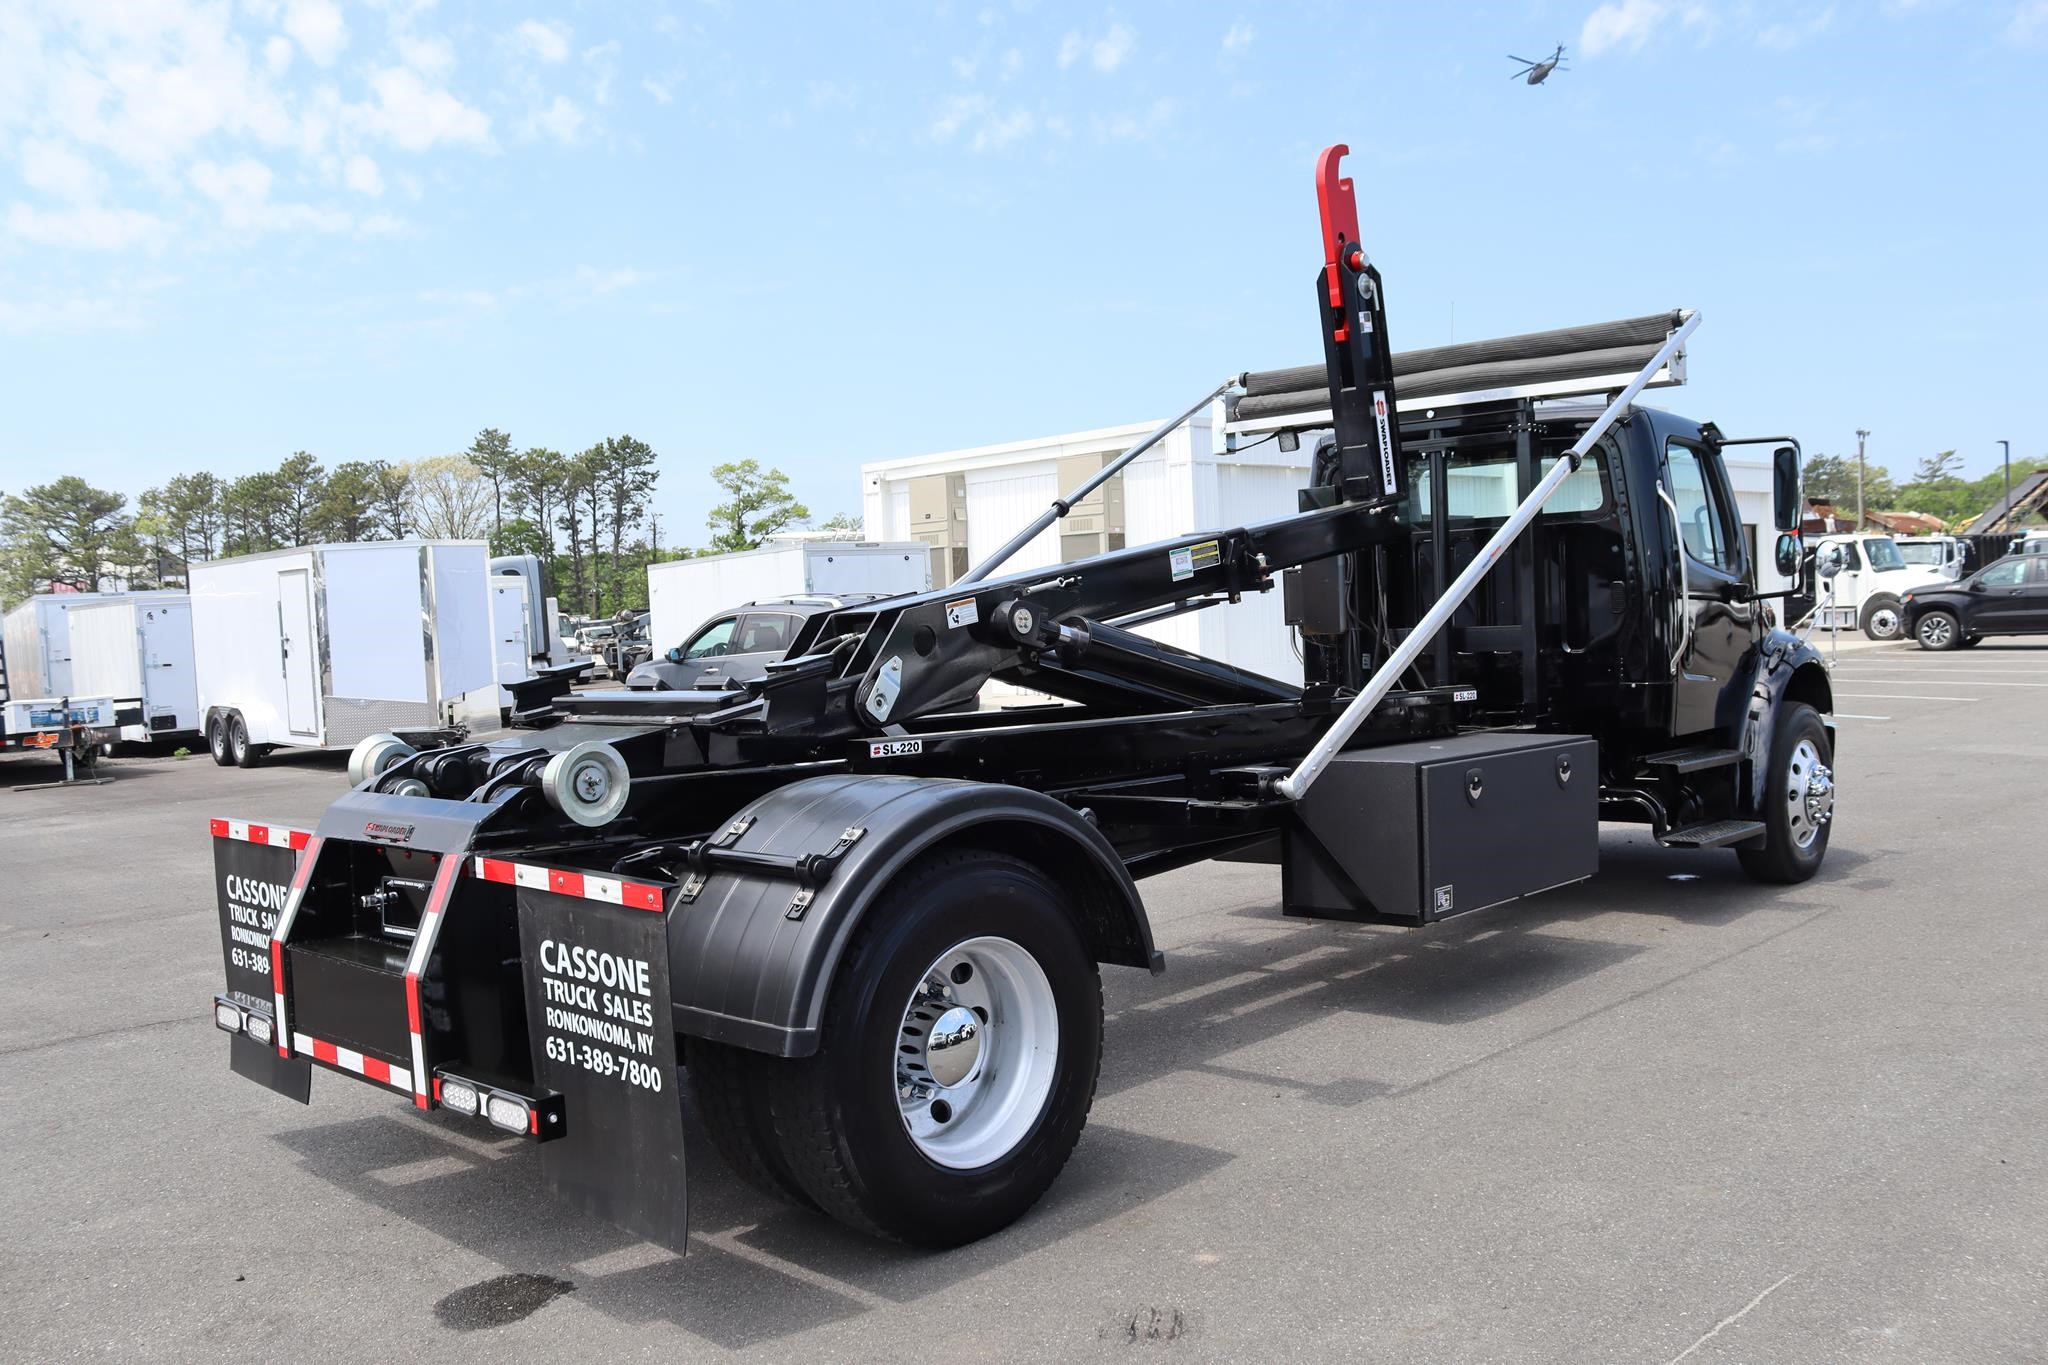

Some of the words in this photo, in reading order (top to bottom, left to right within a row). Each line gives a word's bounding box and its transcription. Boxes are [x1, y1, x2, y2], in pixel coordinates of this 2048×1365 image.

[1380, 418, 1392, 486] SWAPLOADER
[228, 903, 259, 928] TRUCK
[231, 925, 270, 950] RONKONKO
[232, 947, 271, 975] 631-389-
[540, 939, 651, 997] CASSONE
[542, 977, 598, 1013] TRUCK
[602, 992, 653, 1028] SALES
[546, 1006, 636, 1054] RONKONKOMA,
[637, 1031, 654, 1056] NY
[545, 1035, 662, 1093] 631-389-7800
